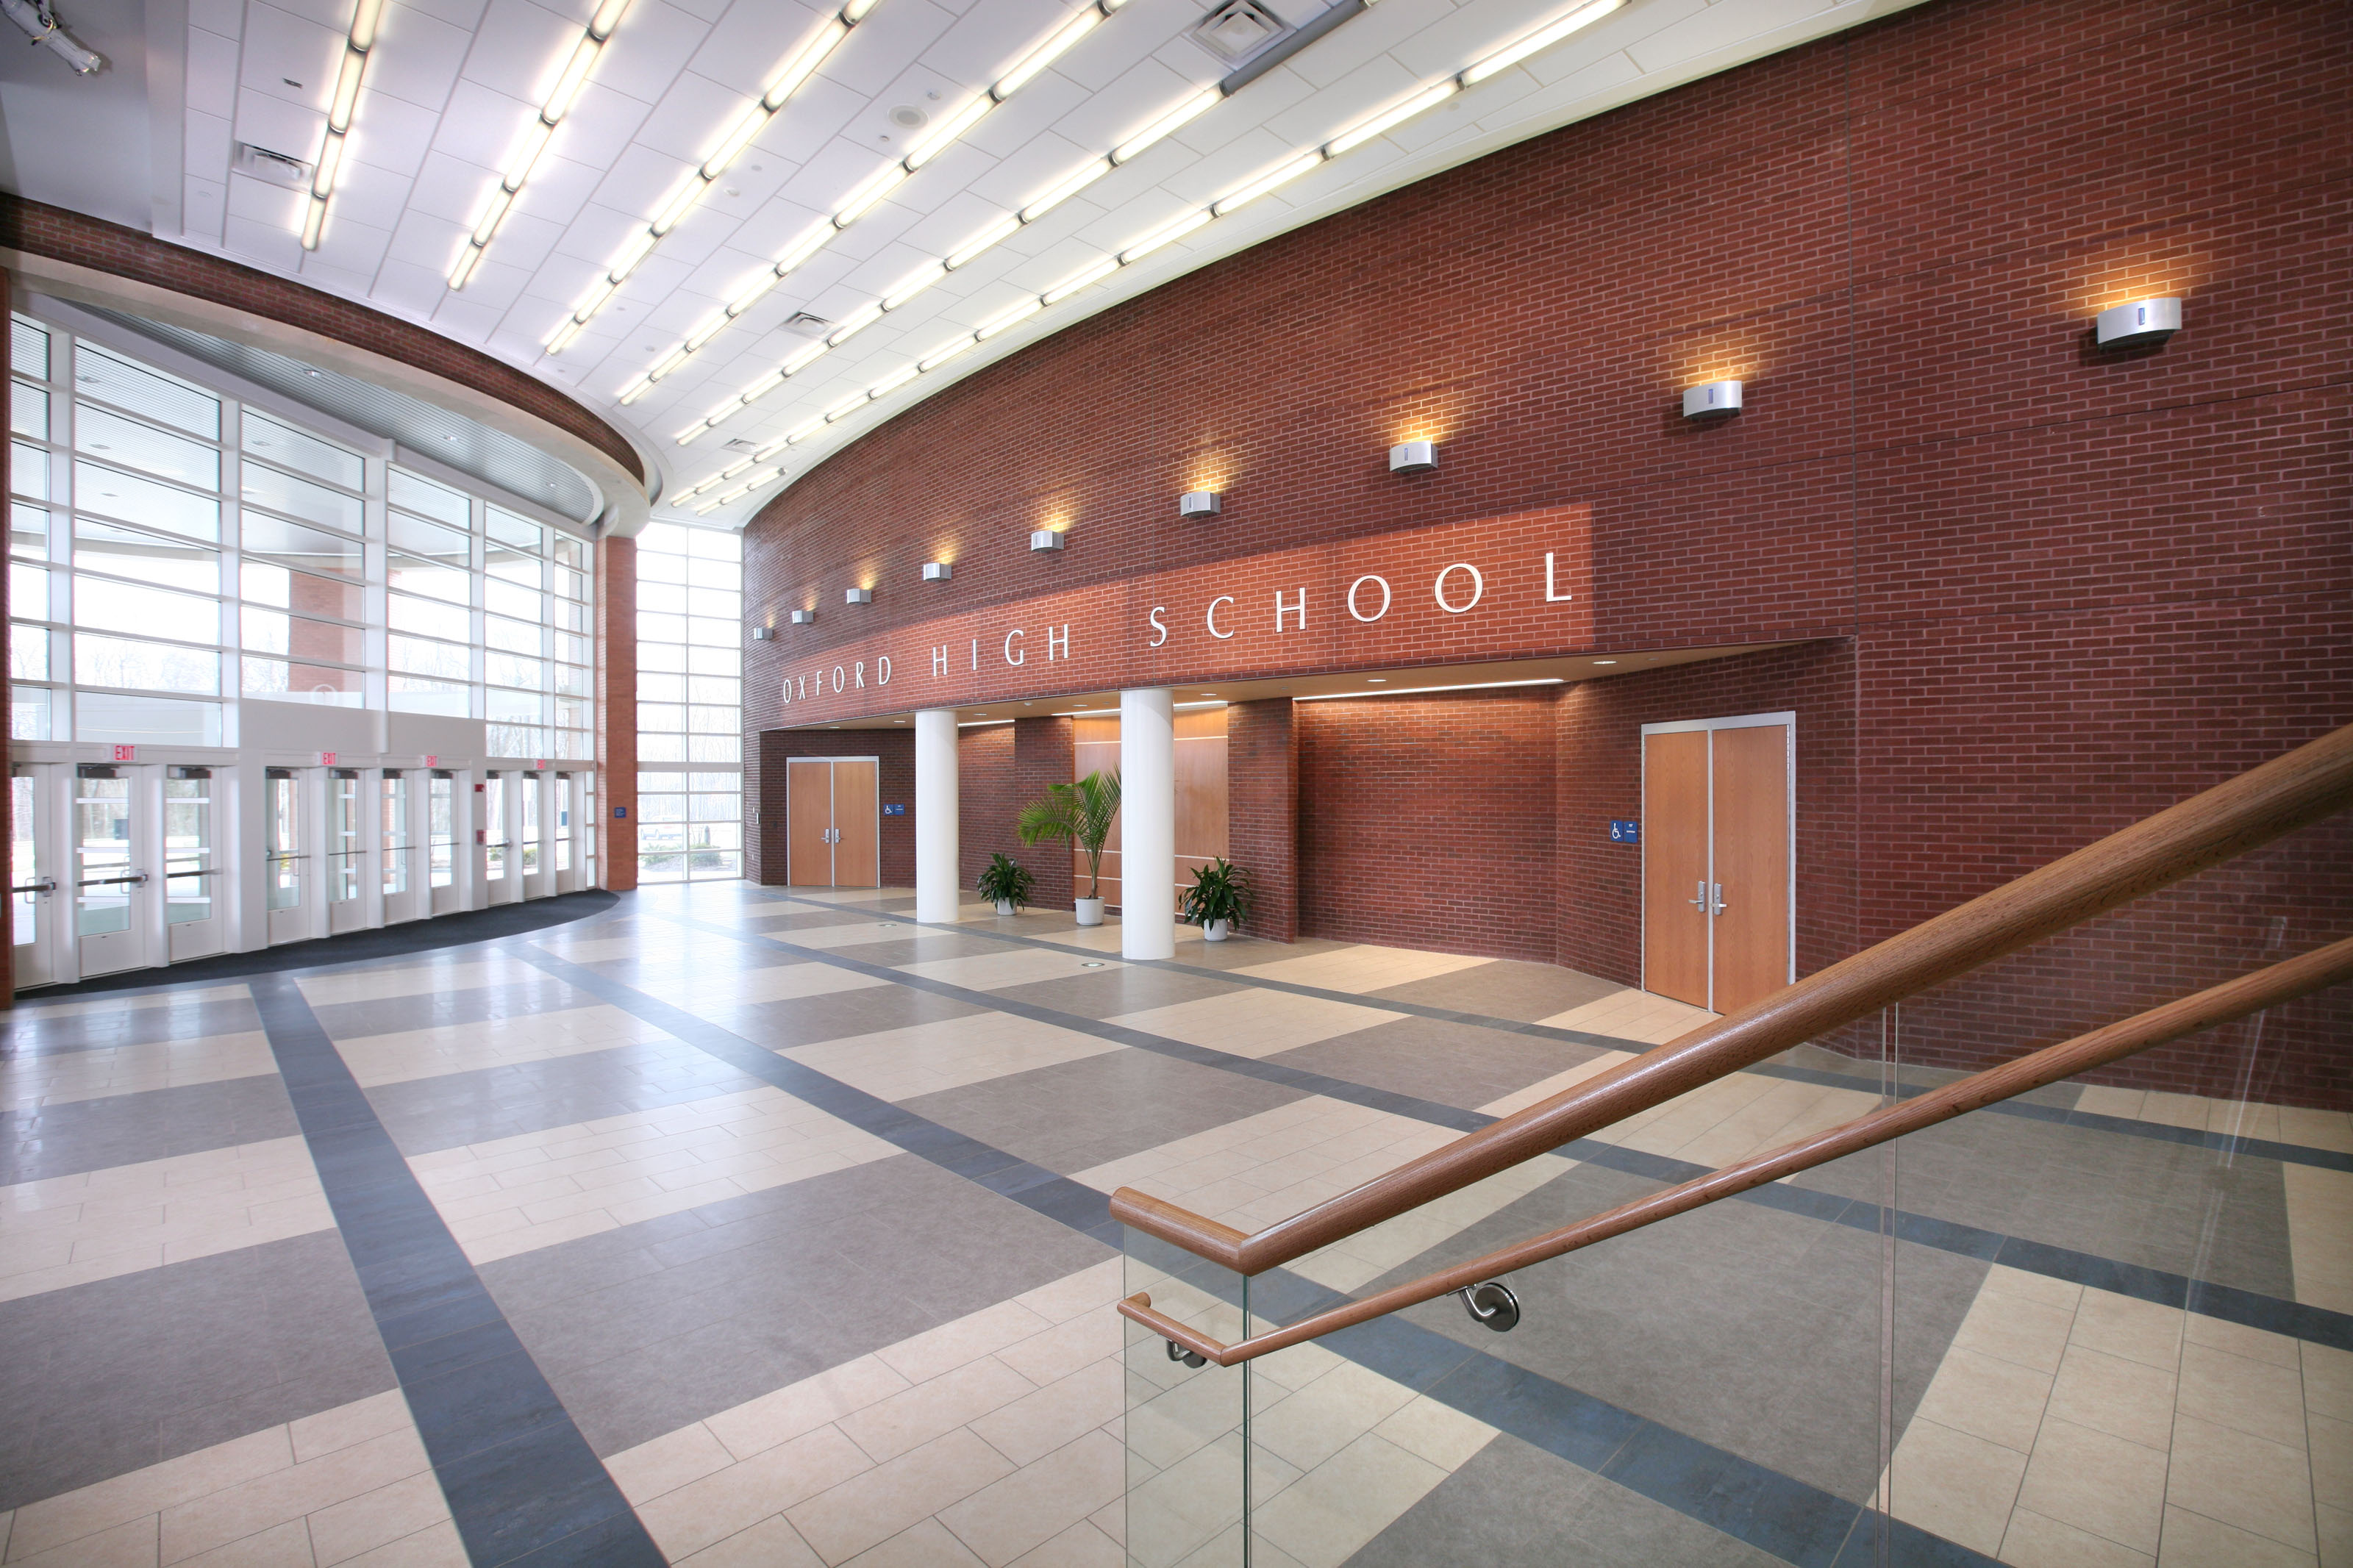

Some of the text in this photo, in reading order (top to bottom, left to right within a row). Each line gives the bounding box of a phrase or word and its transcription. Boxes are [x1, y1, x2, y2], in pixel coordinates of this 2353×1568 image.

[782, 552, 1572, 704] OXFORD HIGH SCHOOL
[115, 745, 135, 761] EXIT
[322, 752, 336, 765] EXIT
